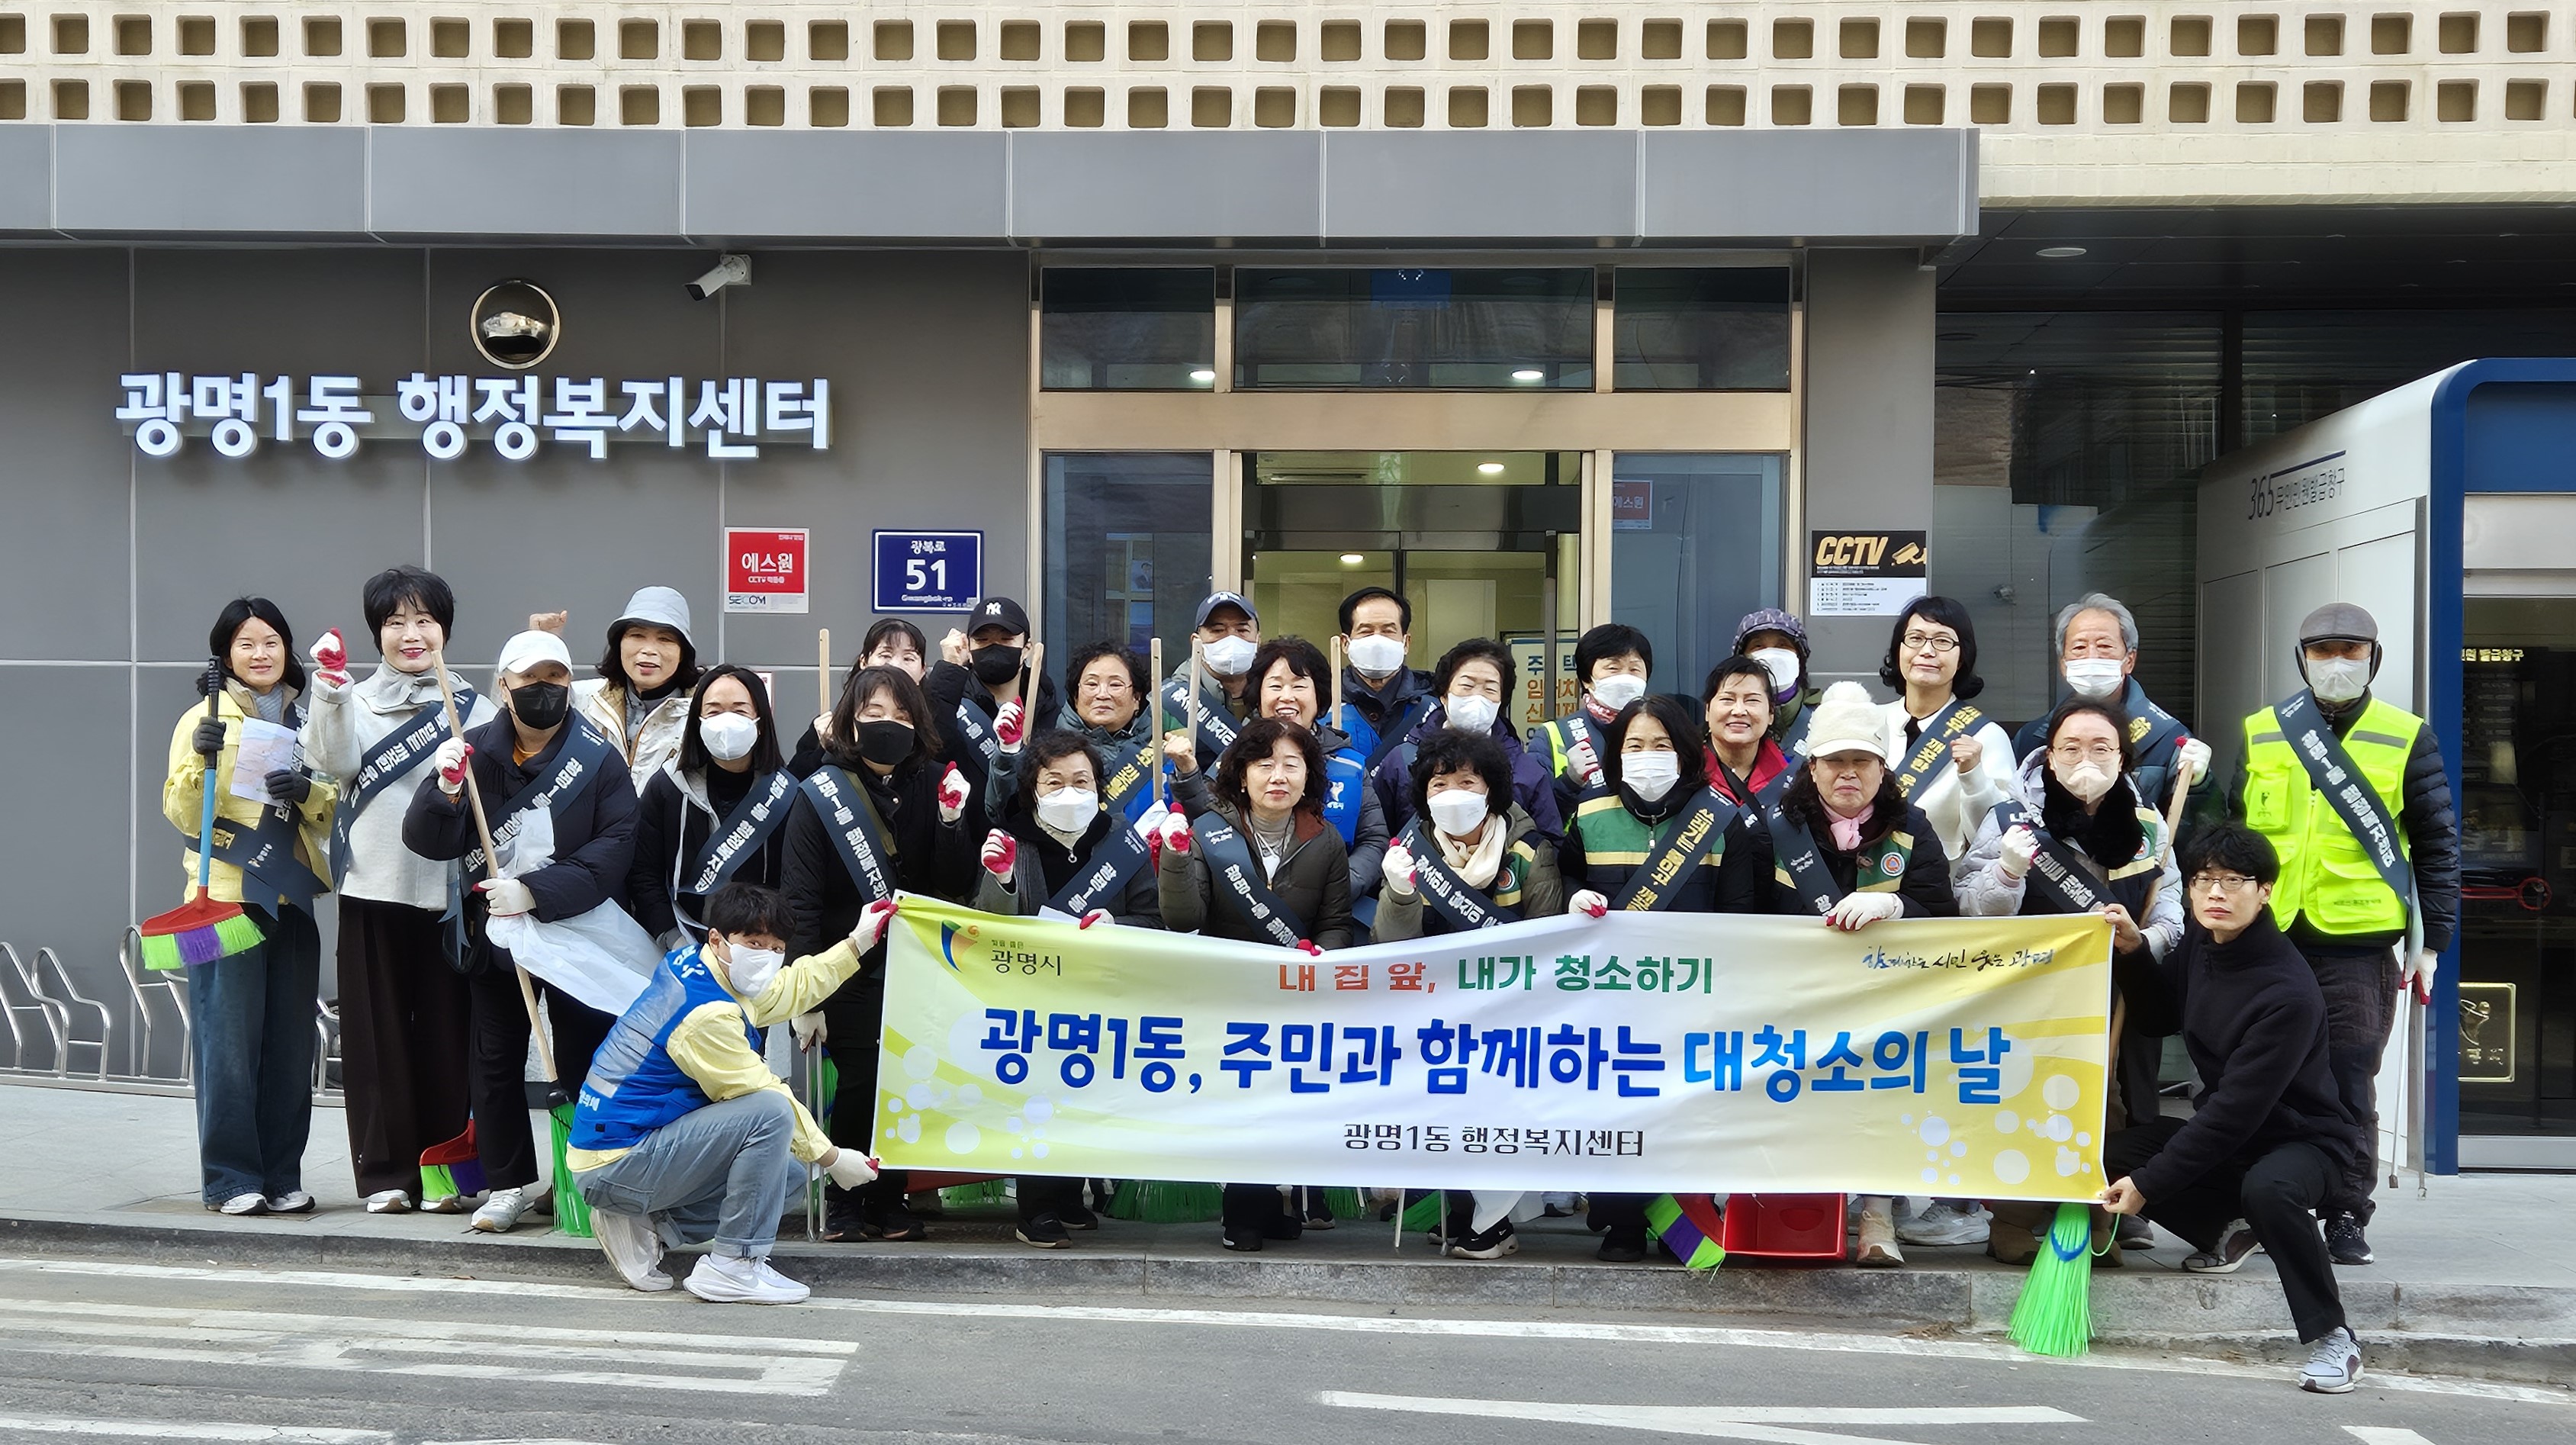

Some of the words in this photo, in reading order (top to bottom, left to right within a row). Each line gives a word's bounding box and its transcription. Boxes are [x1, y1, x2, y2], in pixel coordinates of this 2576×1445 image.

[115, 371, 375, 460] 광명1동
[397, 371, 831, 462] 행정복지센터
[741, 552, 793, 573] 에스원
[1815, 536, 1889, 565] CCTV
[906, 559, 946, 591] 51
[532, 756, 585, 809] 광명1동
[810, 764, 856, 826] 광명1동
[1068, 860, 1118, 914] 광명1동
[1223, 863, 1271, 920] 광명1동
[990, 949, 1062, 977] 광명시
[1278, 964, 1316, 992] 내
[1334, 963, 1369, 992] 집
[1388, 962, 1436, 994] 앞,
[1458, 956, 1536, 993] 내가
[1554, 954, 1713, 995] 청소하기
[1933, 948, 1967, 969] 시민
[979, 1007, 1202, 1095] 광명1동,
[1220, 1021, 1402, 1094] 주민과
[1416, 1019, 1666, 1098] 함께하는
[1683, 1022, 1928, 1104] 대청소의
[1949, 1027, 2012, 1105] 날
[1343, 1123, 1452, 1154] 광명1동
[1461, 1125, 1645, 1157] 행정복지센터
